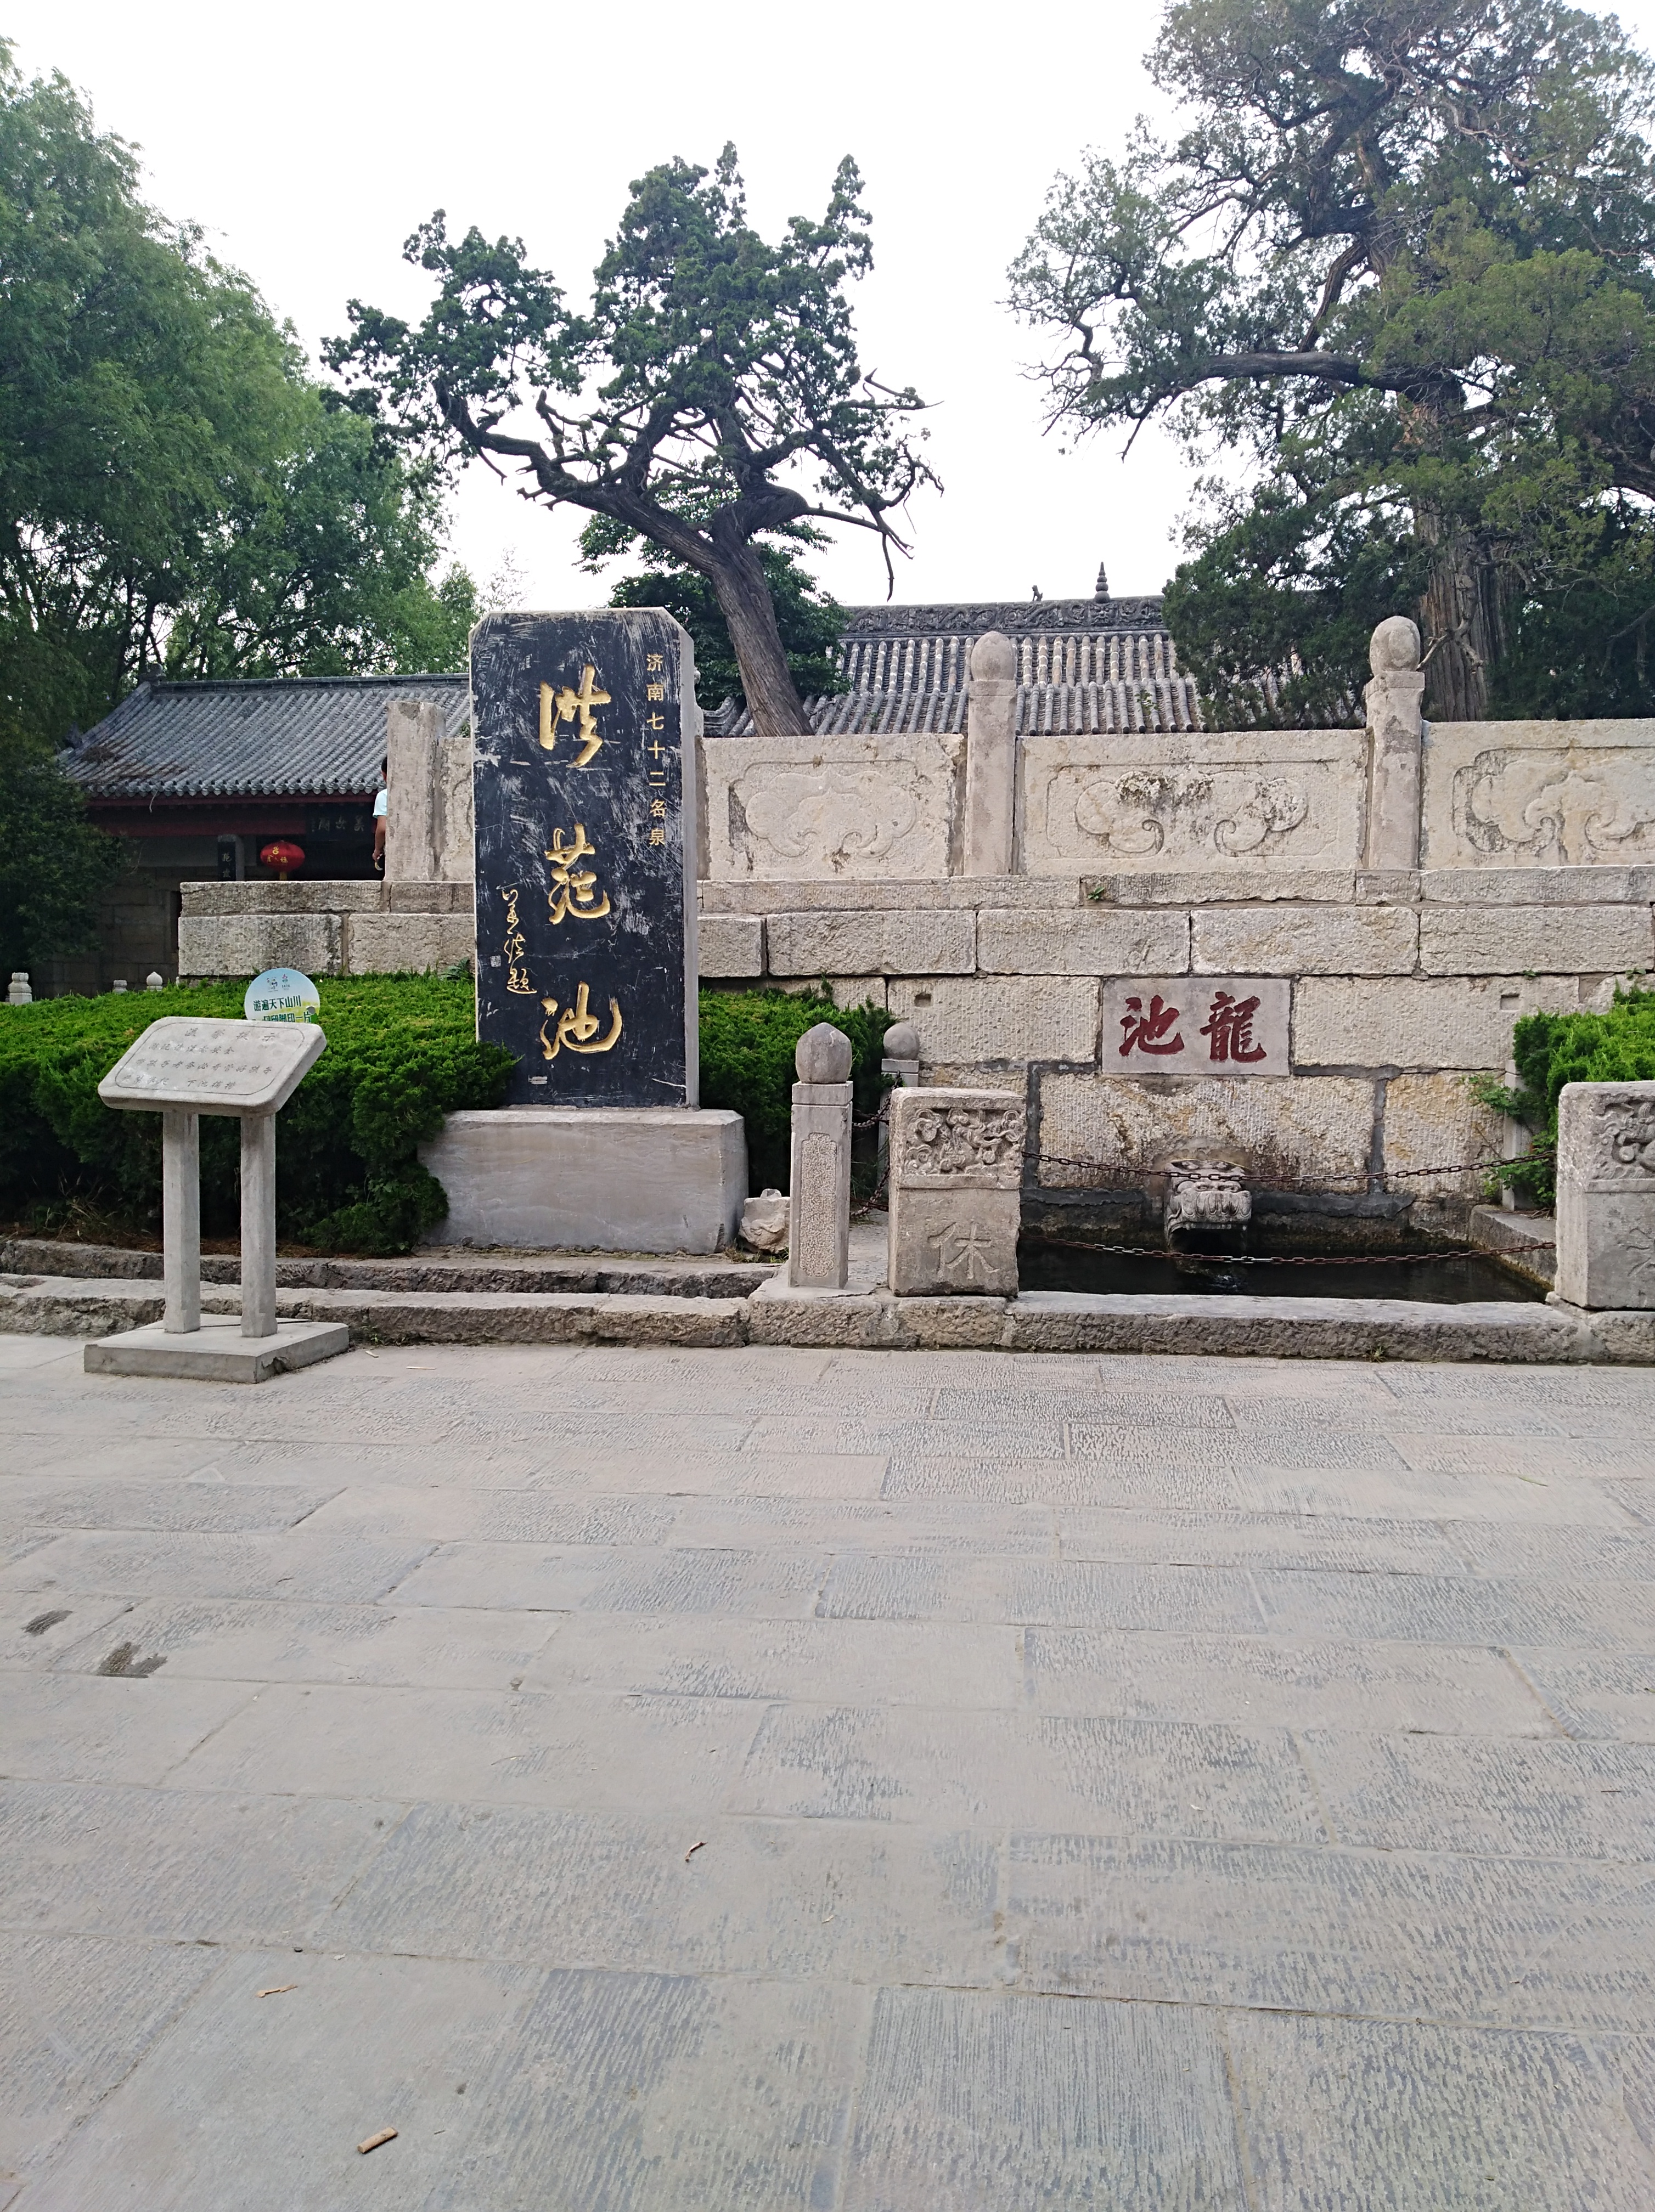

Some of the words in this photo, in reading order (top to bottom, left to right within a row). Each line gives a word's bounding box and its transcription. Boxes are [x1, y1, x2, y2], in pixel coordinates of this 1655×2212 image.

[646, 653, 666, 845] 济南七十二名泉
[253, 995, 301, 1011] 游遍天下山川
[927, 1221, 1001, 1283] 休
